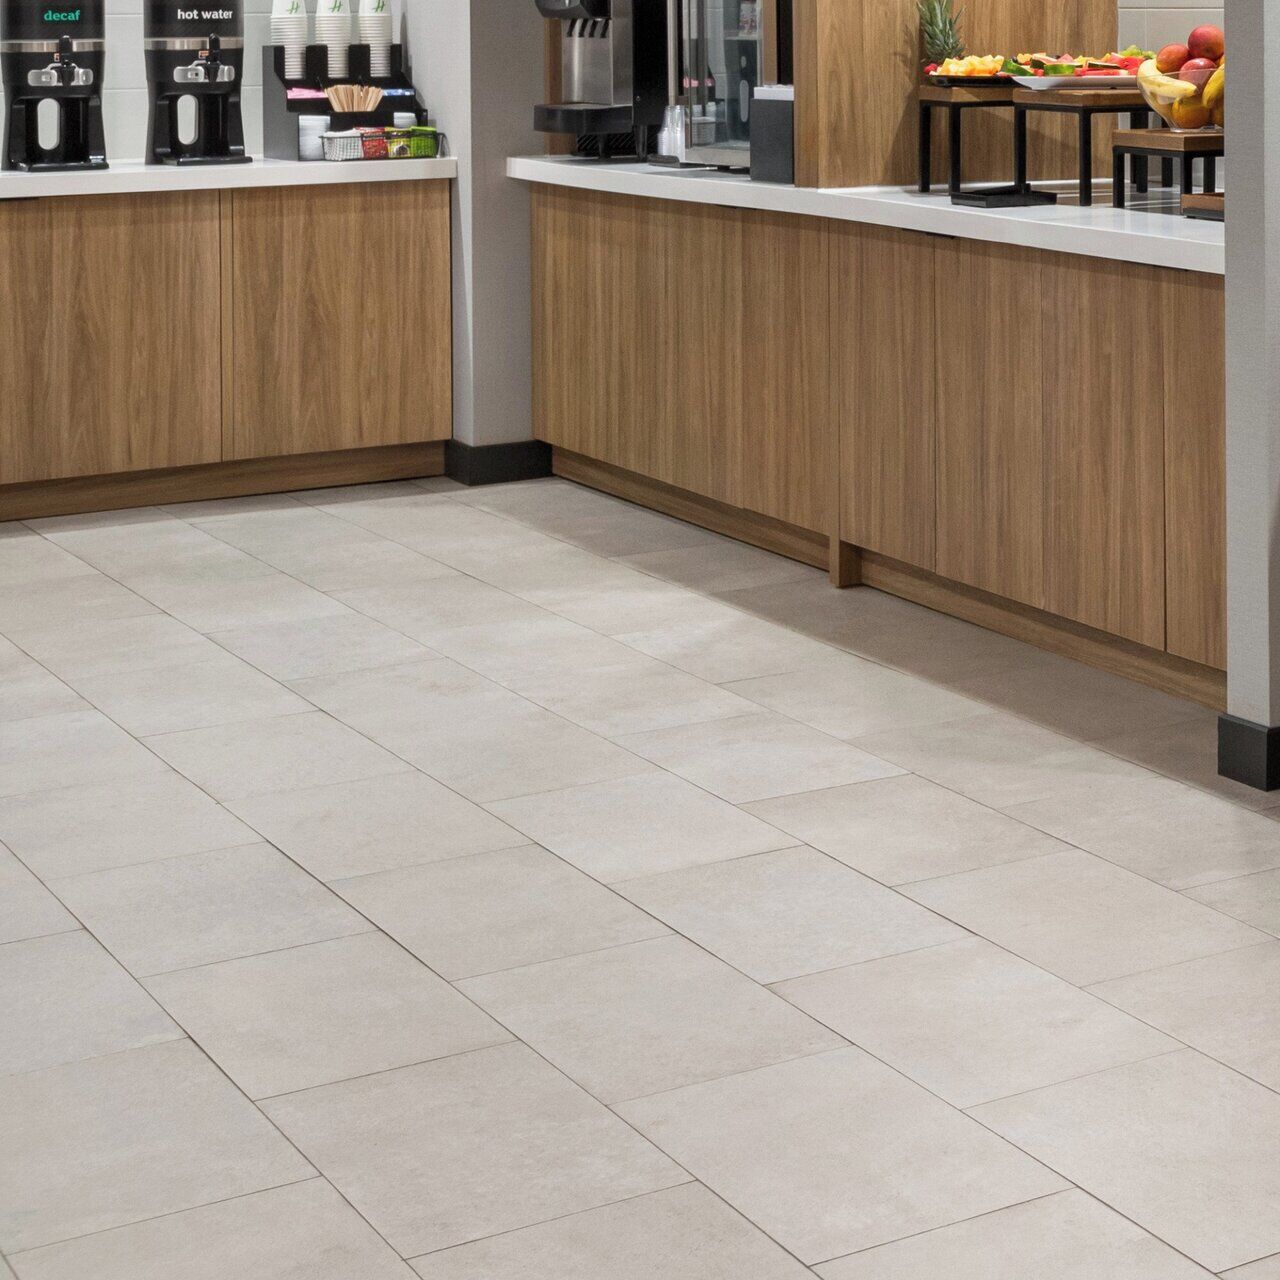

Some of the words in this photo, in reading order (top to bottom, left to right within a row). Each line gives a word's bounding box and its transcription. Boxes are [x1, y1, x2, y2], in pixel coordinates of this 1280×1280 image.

[44, 10, 80, 21] decaf
[177, 9, 199, 19] hot
[201, 10, 233, 19] water
